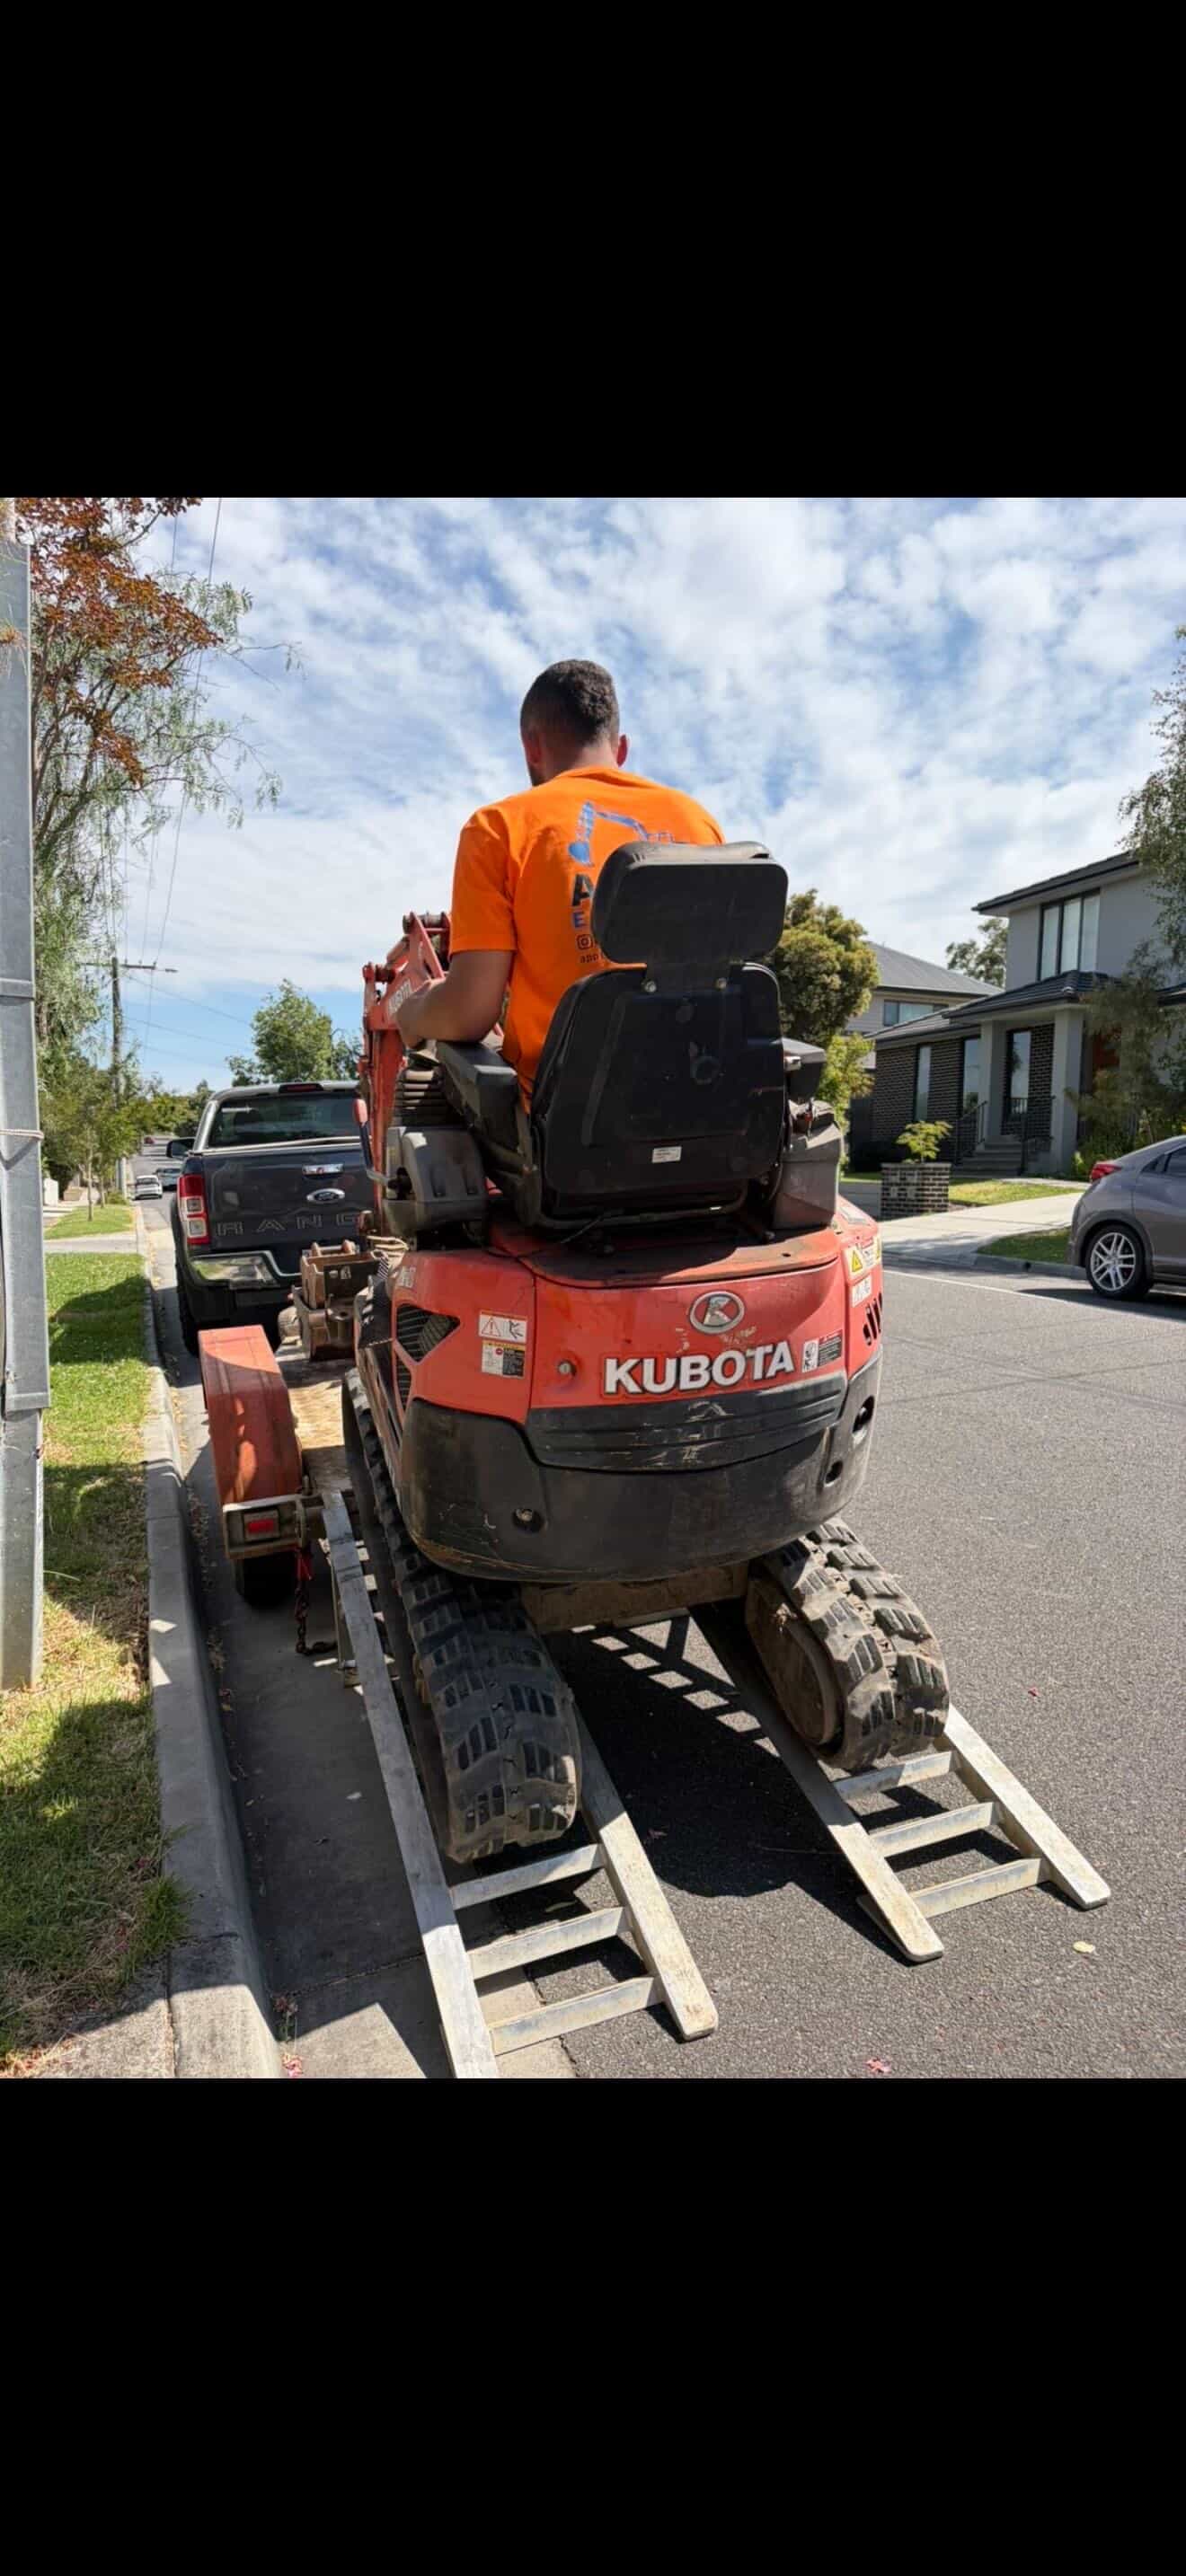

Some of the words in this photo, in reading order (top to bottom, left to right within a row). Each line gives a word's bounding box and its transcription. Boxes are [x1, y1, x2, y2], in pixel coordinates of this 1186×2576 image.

[571, 873, 594, 906] A
[217, 1214, 357, 1236] RANG
[605, 1341, 794, 1393] KUBOTA
